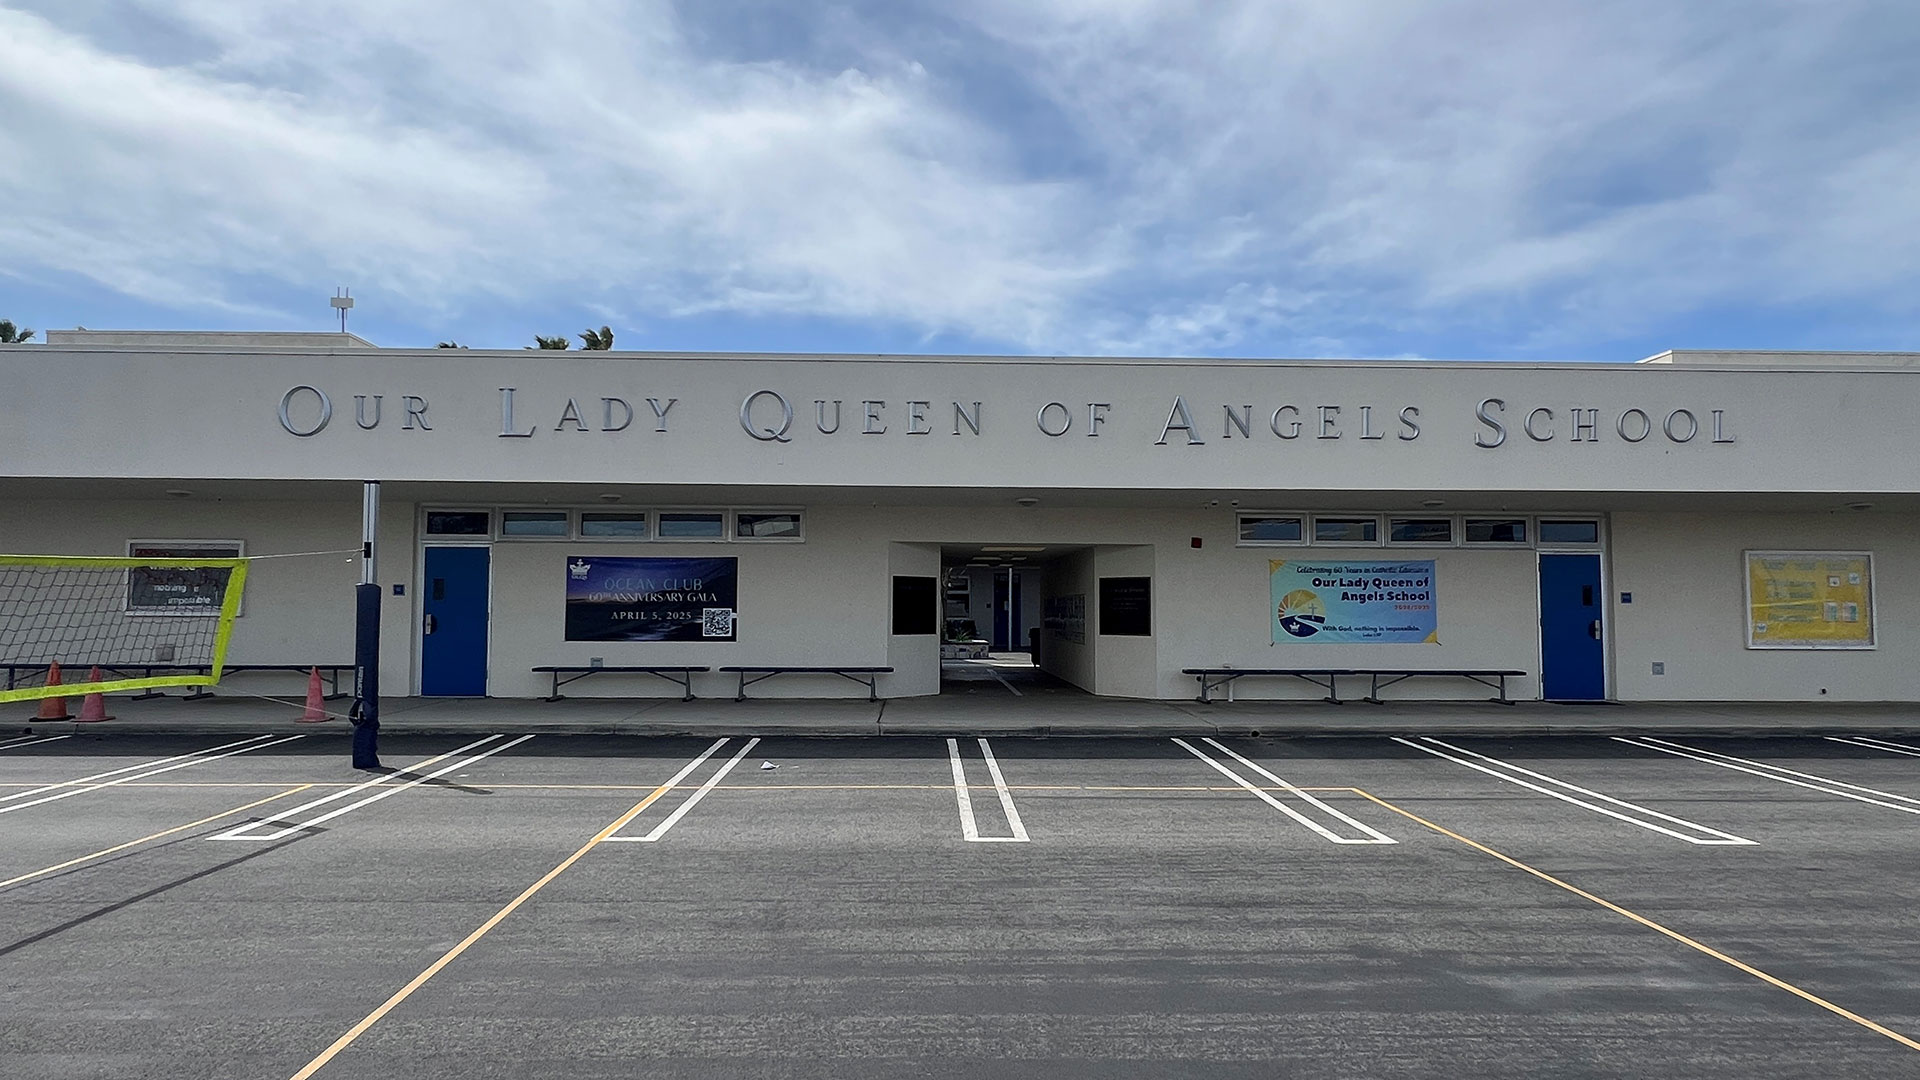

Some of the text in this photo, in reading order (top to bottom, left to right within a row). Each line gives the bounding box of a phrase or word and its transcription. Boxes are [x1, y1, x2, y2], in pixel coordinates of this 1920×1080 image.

[278, 384, 1735, 449] OUR LADY QUEEN OF ANGELS SCHOOL
[1344, 566, 1363, 574] Years
[604, 577, 655, 591] OCEAN
[663, 578, 703, 591] CLUB
[1312, 577, 1430, 590] Our Lady Queen of
[613, 592, 685, 602] ANNIVERSARY
[687, 592, 718, 602] GALA
[1341, 591, 1430, 604] Angels School
[611, 611, 692, 621] APRIL 5, 2025
[1338, 625, 1352, 633] God,
[1354, 625, 1378, 633] nothing
